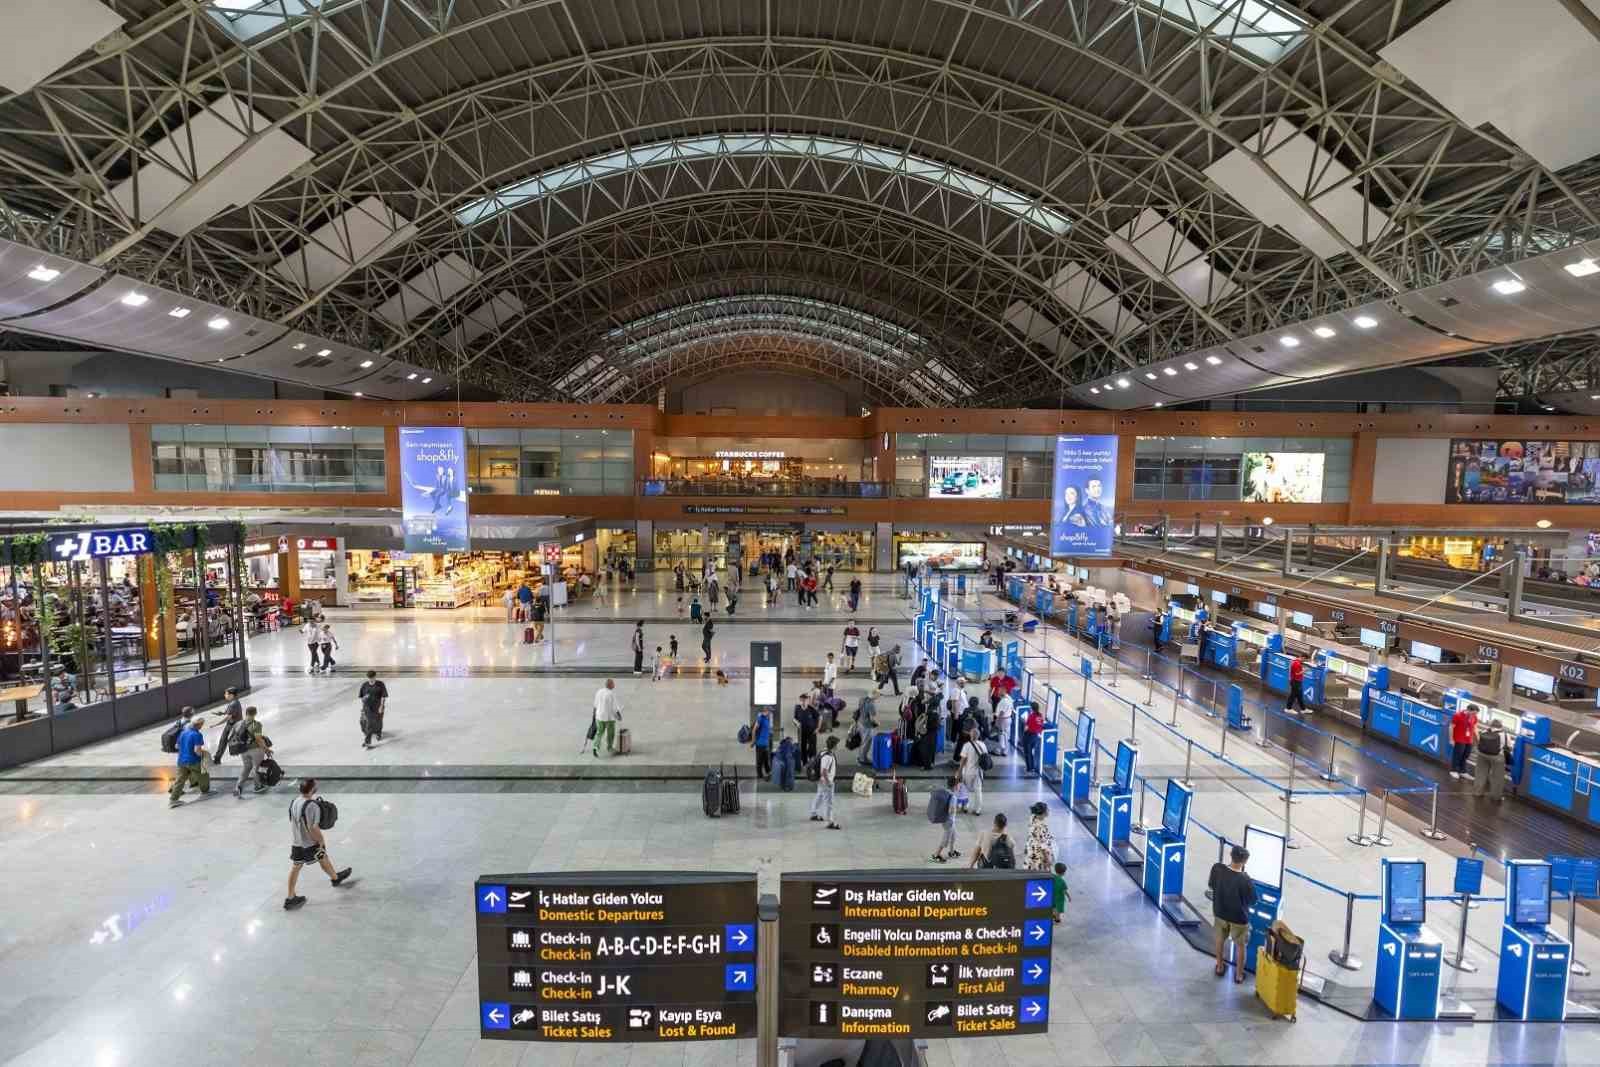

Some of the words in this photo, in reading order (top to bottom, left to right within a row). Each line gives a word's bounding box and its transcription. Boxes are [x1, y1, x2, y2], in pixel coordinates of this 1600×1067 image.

[416, 448, 460, 464] shop&fly
[715, 450, 758, 458] STARBUCKS
[758, 450, 785, 458] COFFEE
[56, 532, 92, 561] +1
[94, 533, 148, 555] BAR
[1380, 620, 1397, 634] K04
[1478, 645, 1499, 659] K03
[1559, 663, 1584, 680] K02
[539, 891, 550, 907] İç
[552, 893, 588, 905] Hatlar
[593, 893, 627, 904] Giden
[630, 893, 663, 904] Yolcu
[845, 890, 863, 904] Dış
[867, 890, 904, 902] Hatlar
[906, 890, 941, 902] Giden
[943, 889, 974, 901] Yolcu
[540, 910, 594, 921] Domestic
[598, 910, 664, 922] Departures
[845, 907, 920, 918] International
[924, 906, 988, 919] Departures
[844, 929, 881, 943] Engelli
[884, 929, 913, 941] Yolcu
[915, 929, 962, 943] Danışma
[965, 928, 974, 939] &
[976, 926, 1021, 939] Check-in
[540, 932, 591, 945] Check-in
[597, 934, 720, 955] A-B-C-D-E-F-G-H
[844, 945, 891, 957] Disabled
[894, 945, 958, 957] Information
[961, 944, 970, 955] &
[972, 943, 1017, 955] Check-in
[541, 949, 591, 960] Check-in
[843, 969, 883, 980] Eczane
[959, 966, 972, 978] İlk
[975, 966, 1014, 978] Yardım
[541, 972, 592, 984] Check-in
[597, 976, 631, 996] J-K
[842, 984, 900, 997] Pharmacy
[958, 983, 985, 994] First
[987, 982, 1005, 993] Aid
[542, 988, 592, 999] Check-in
[542, 1011, 570, 1022] Bilet
[572, 1010, 600, 1024] Satış
[659, 1010, 692, 1024] Kayıp
[695, 1009, 722, 1024] Eşya
[842, 1007, 892, 1020] Danışma
[957, 1005, 984, 1016] Bilet
[986, 1004, 1014, 1017] Satış
[659, 1026, 684, 1037] Lost
[688, 1026, 697, 1036] &
[700, 1024, 736, 1036] Found
[842, 1022, 910, 1033] Information
[957, 1021, 986, 1031] Ticket
[988, 1019, 1016, 1031] Sales
[542, 1026, 578, 1037] Ticket
[581, 1026, 612, 1038] Sales
